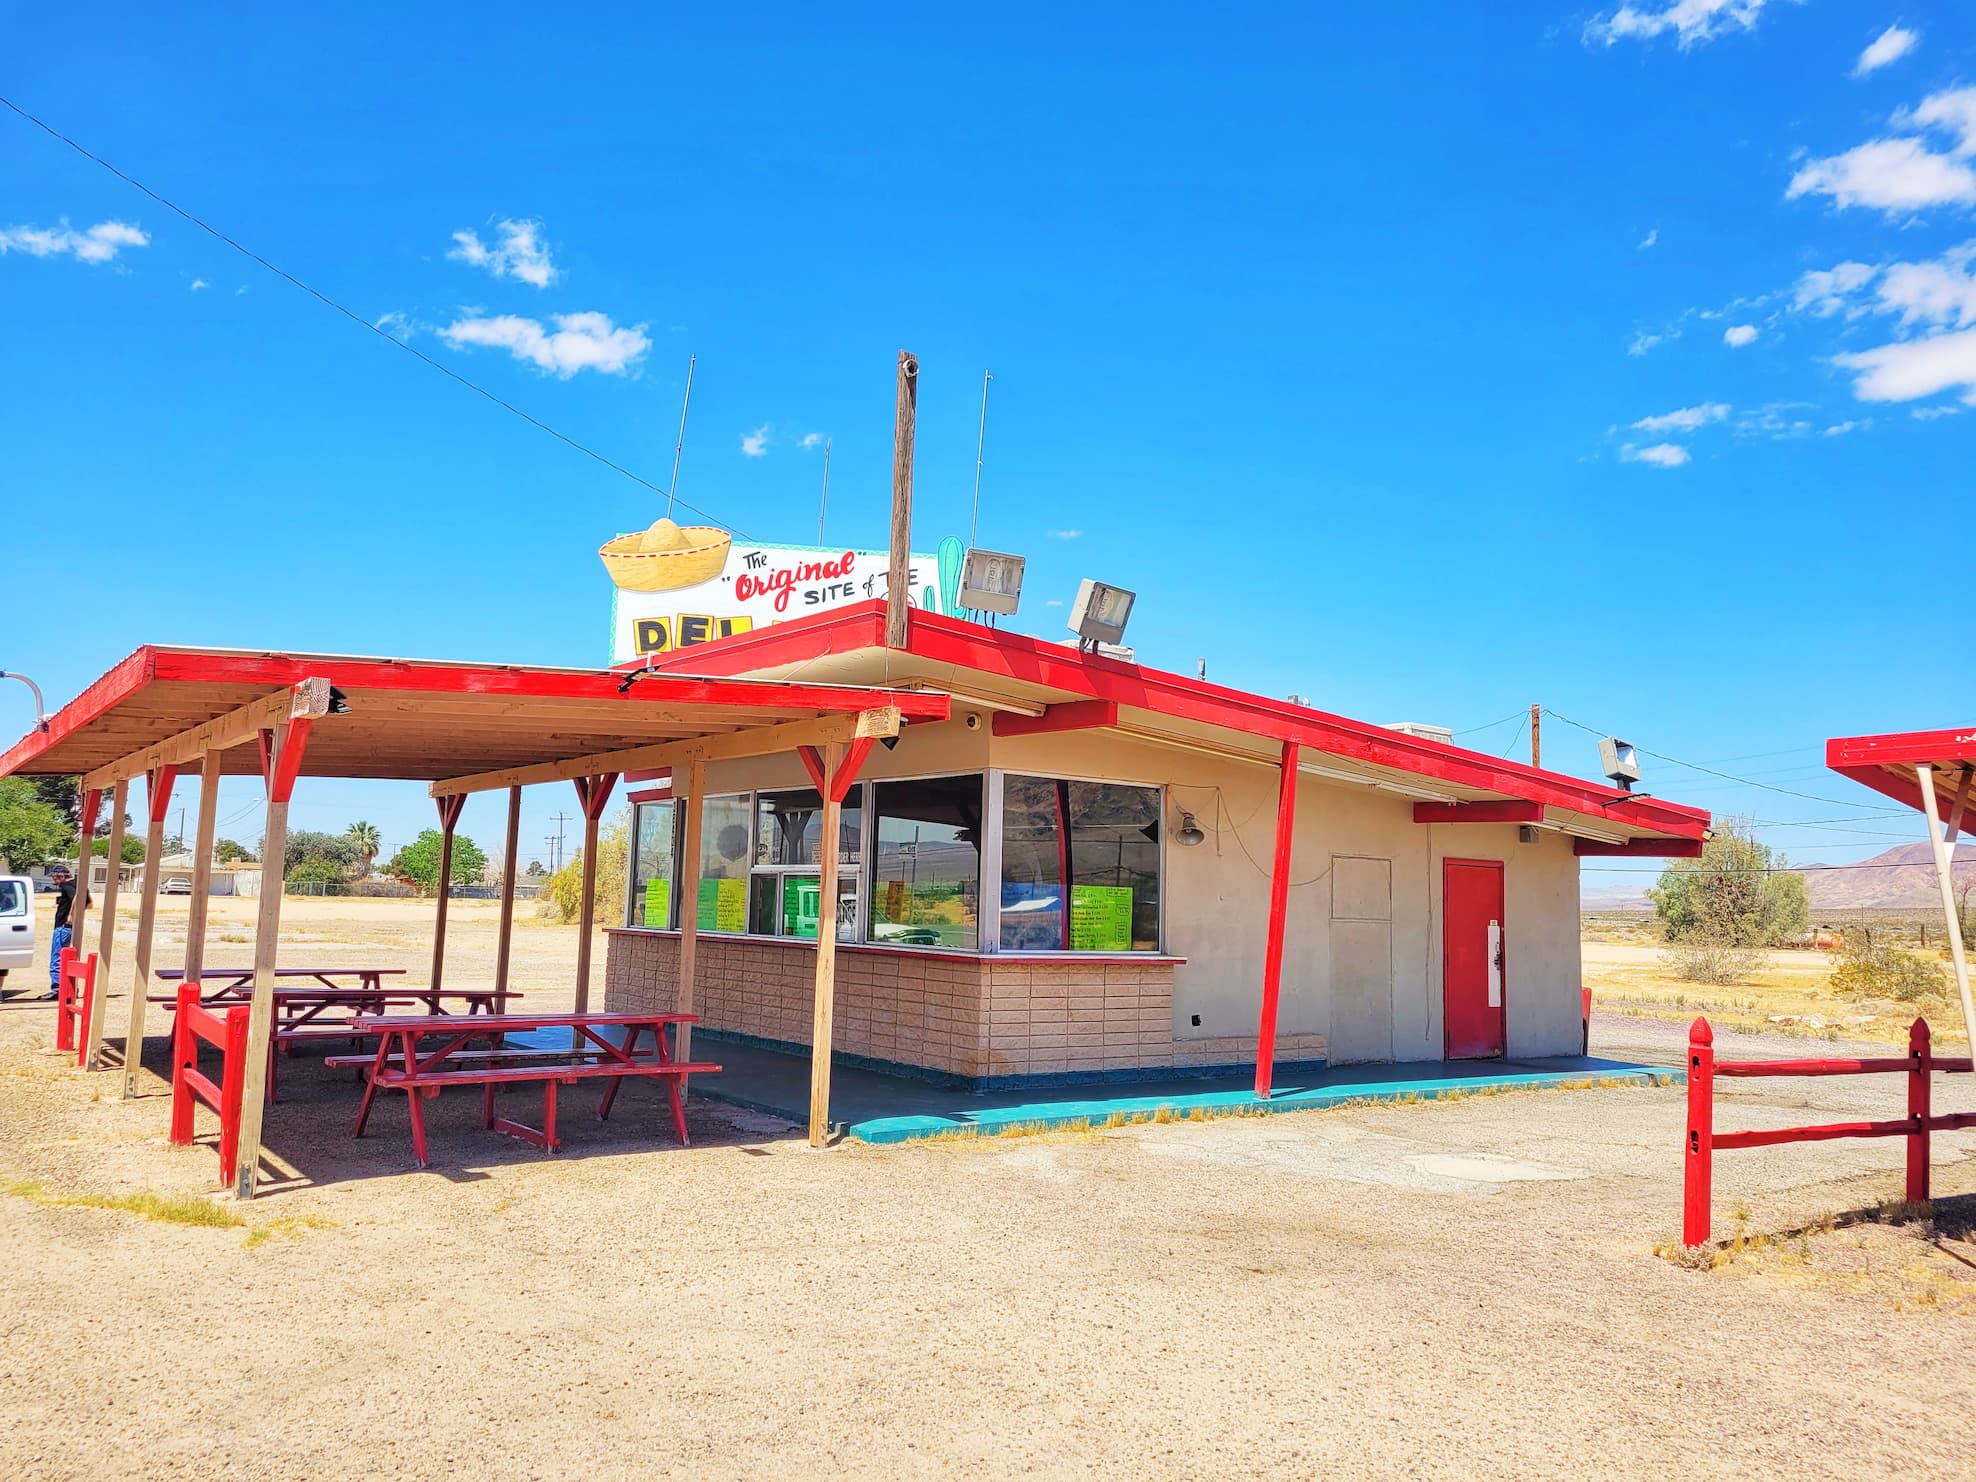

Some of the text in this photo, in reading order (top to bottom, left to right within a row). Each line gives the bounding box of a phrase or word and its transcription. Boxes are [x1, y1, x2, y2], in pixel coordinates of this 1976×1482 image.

[743, 551, 767, 569] The
[804, 569, 918, 605] SITE of TE
